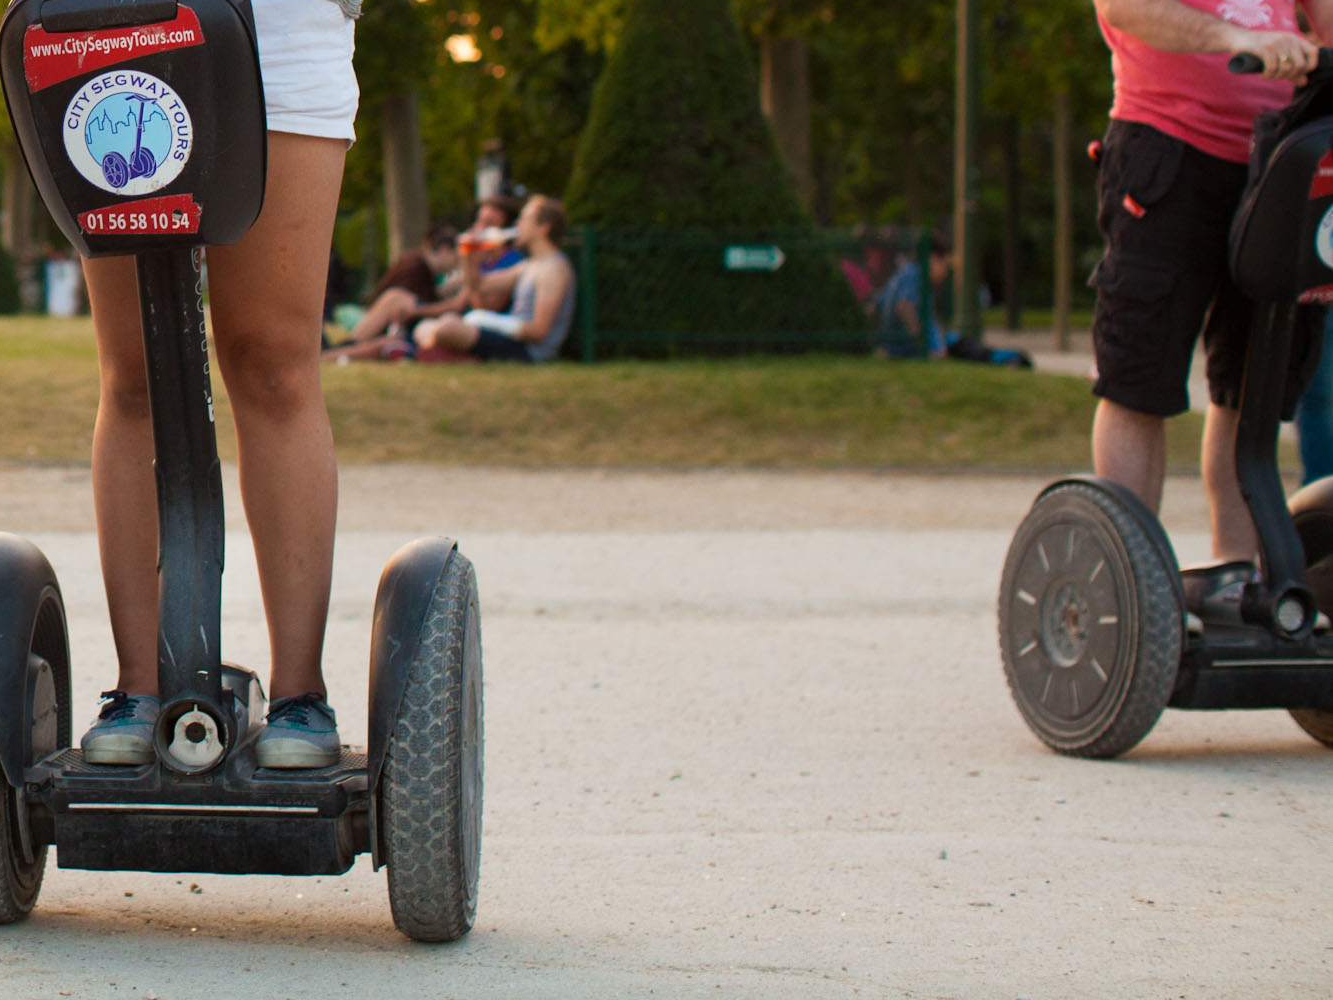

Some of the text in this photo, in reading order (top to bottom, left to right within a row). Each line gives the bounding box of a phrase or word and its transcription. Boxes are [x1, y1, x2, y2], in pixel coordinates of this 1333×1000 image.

[30, 29, 195, 57] www.CitySegwayTours.com
[67, 74, 189, 161] CITY SEGWAY TOURS
[87, 213, 190, 230] 01 56 58 10 54
